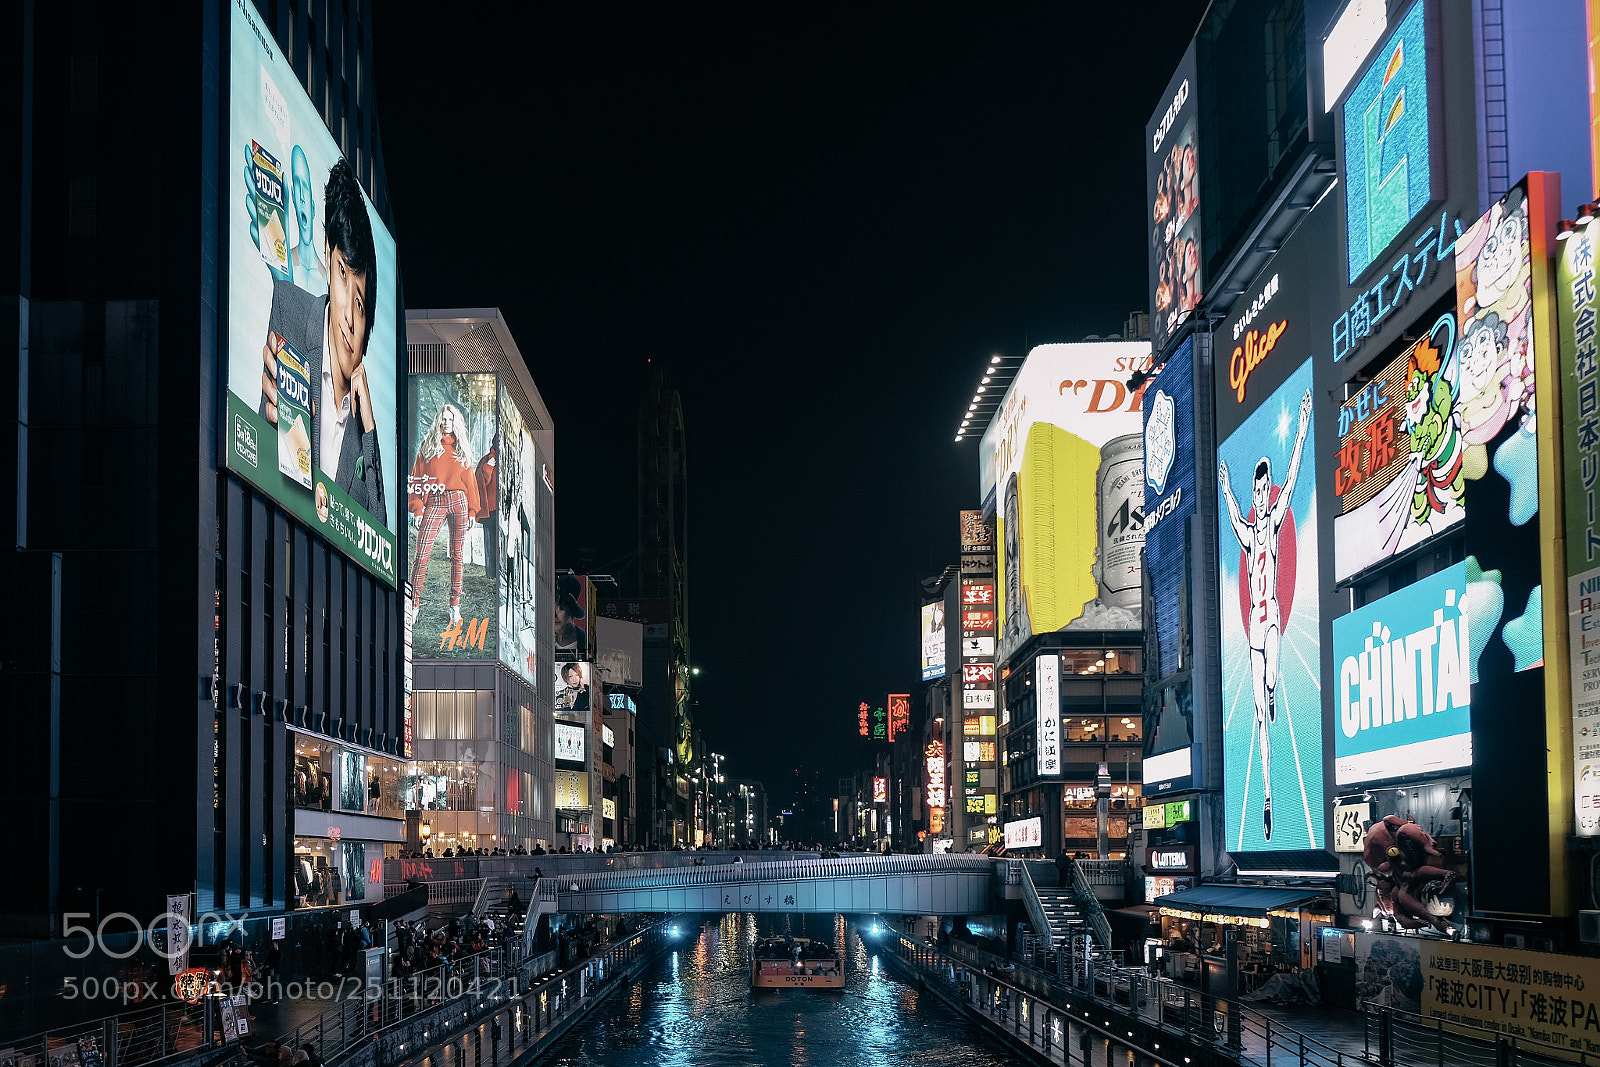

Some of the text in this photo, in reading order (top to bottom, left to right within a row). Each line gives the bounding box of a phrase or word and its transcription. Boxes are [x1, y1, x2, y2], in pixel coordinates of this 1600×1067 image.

[1230, 319, 1287, 403] Glico
[1338, 380, 1389, 438] かぜに
[1334, 409, 1394, 497] 改源
[407, 475, 438, 483] セーター
[407, 483, 446, 496] ¥5,999
[356, 516, 394, 575] サロンパス
[439, 617, 489, 651] H&M
[1340, 588, 1470, 738] CHINTAI
[1044, 716, 1056, 770] かに道楽
[1158, 852, 1186, 867] LOTTERIA
[724, 895, 795, 906] えびす橋
[1570, 1038, 1582, 1050] and
